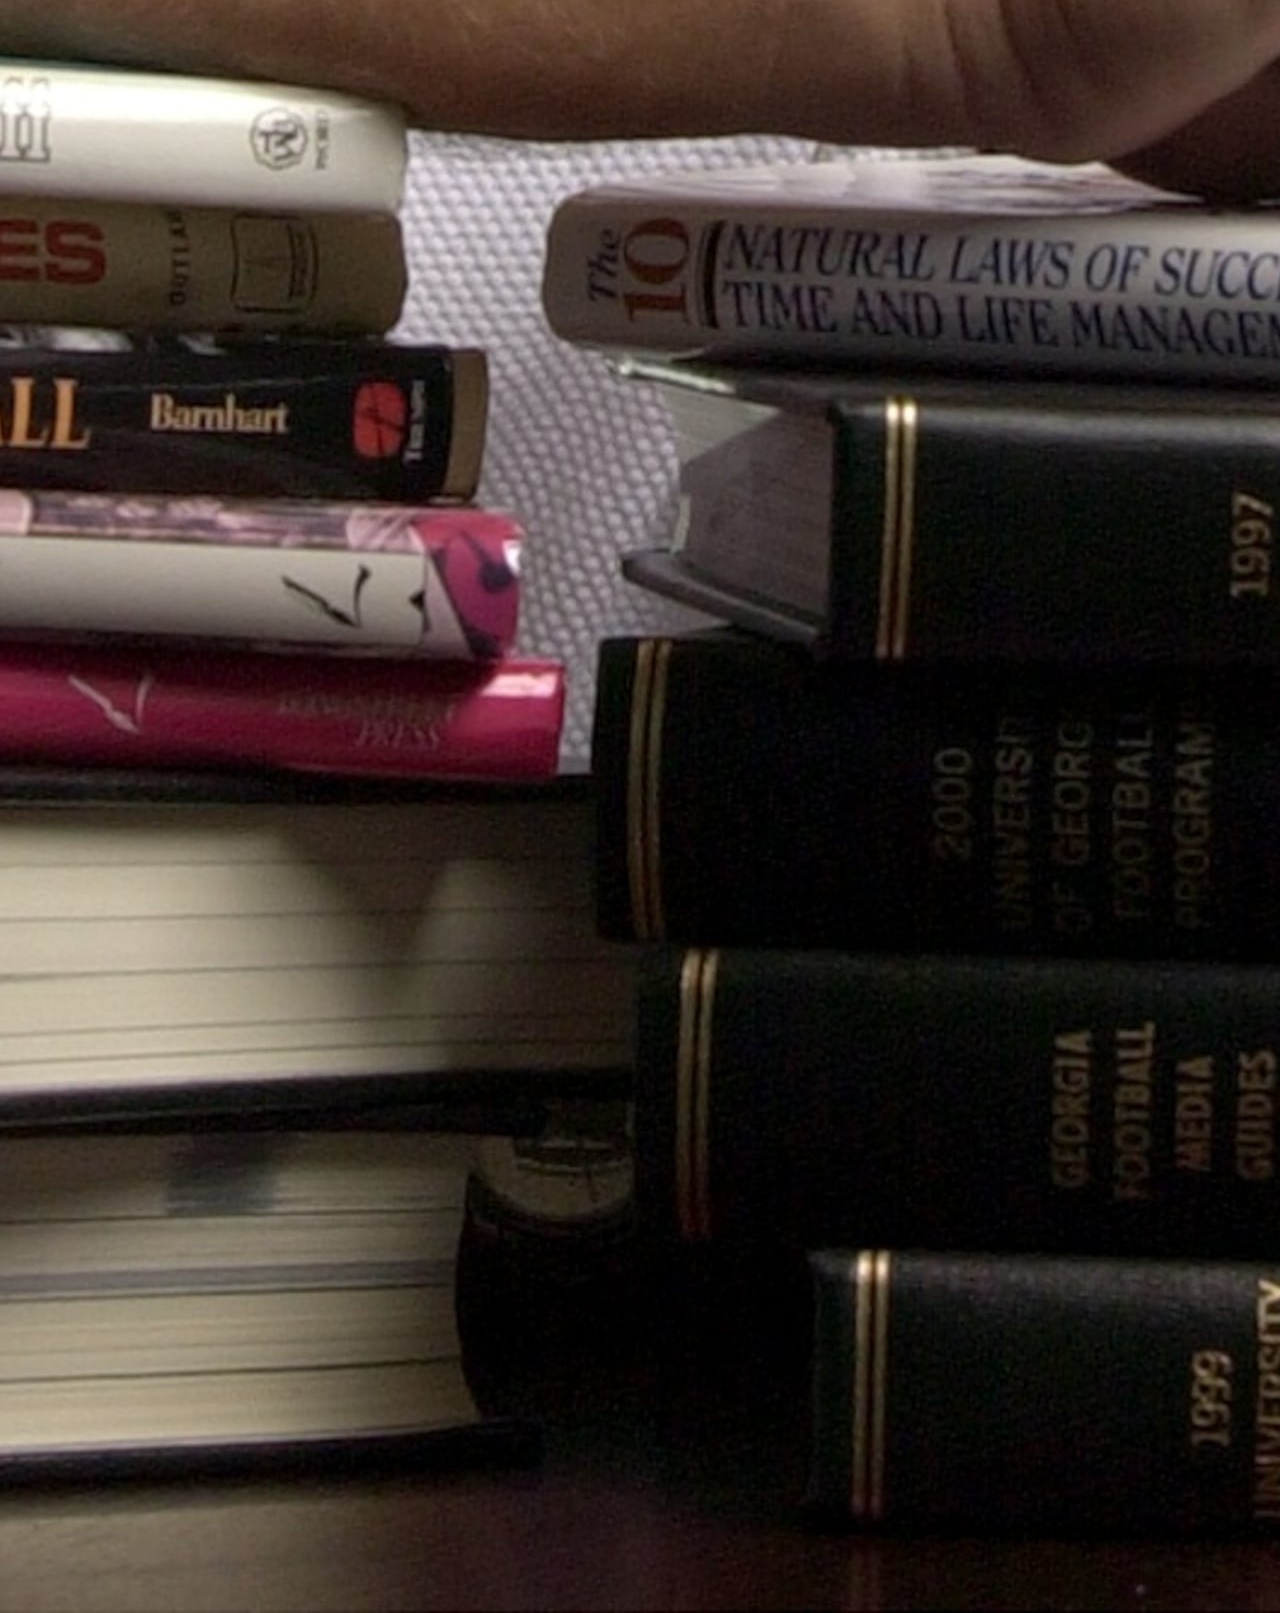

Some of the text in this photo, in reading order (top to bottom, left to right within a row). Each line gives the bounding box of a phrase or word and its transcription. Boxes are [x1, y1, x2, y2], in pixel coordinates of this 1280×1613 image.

[587, 217, 693, 326] The 10
[723, 220, 931, 278] NATURAL
[948, 235, 1073, 293] LAWS
[1084, 242, 1147, 295] OF
[723, 279, 838, 334] TIME
[851, 289, 945, 342] AND
[957, 296, 1059, 348] LIFE
[150, 393, 288, 435] Barnhart
[1230, 491, 1274, 599] 1997
[932, 747, 974, 860] 2000
[1050, 1029, 1094, 1189] GEORGIA
[1113, 1021, 1157, 1201] FOOTBALL
[1173, 1054, 1215, 1174] MEDIA
[1234, 1049, 1277, 1182] GUIDES
[1191, 1348, 1234, 1448] 1999
